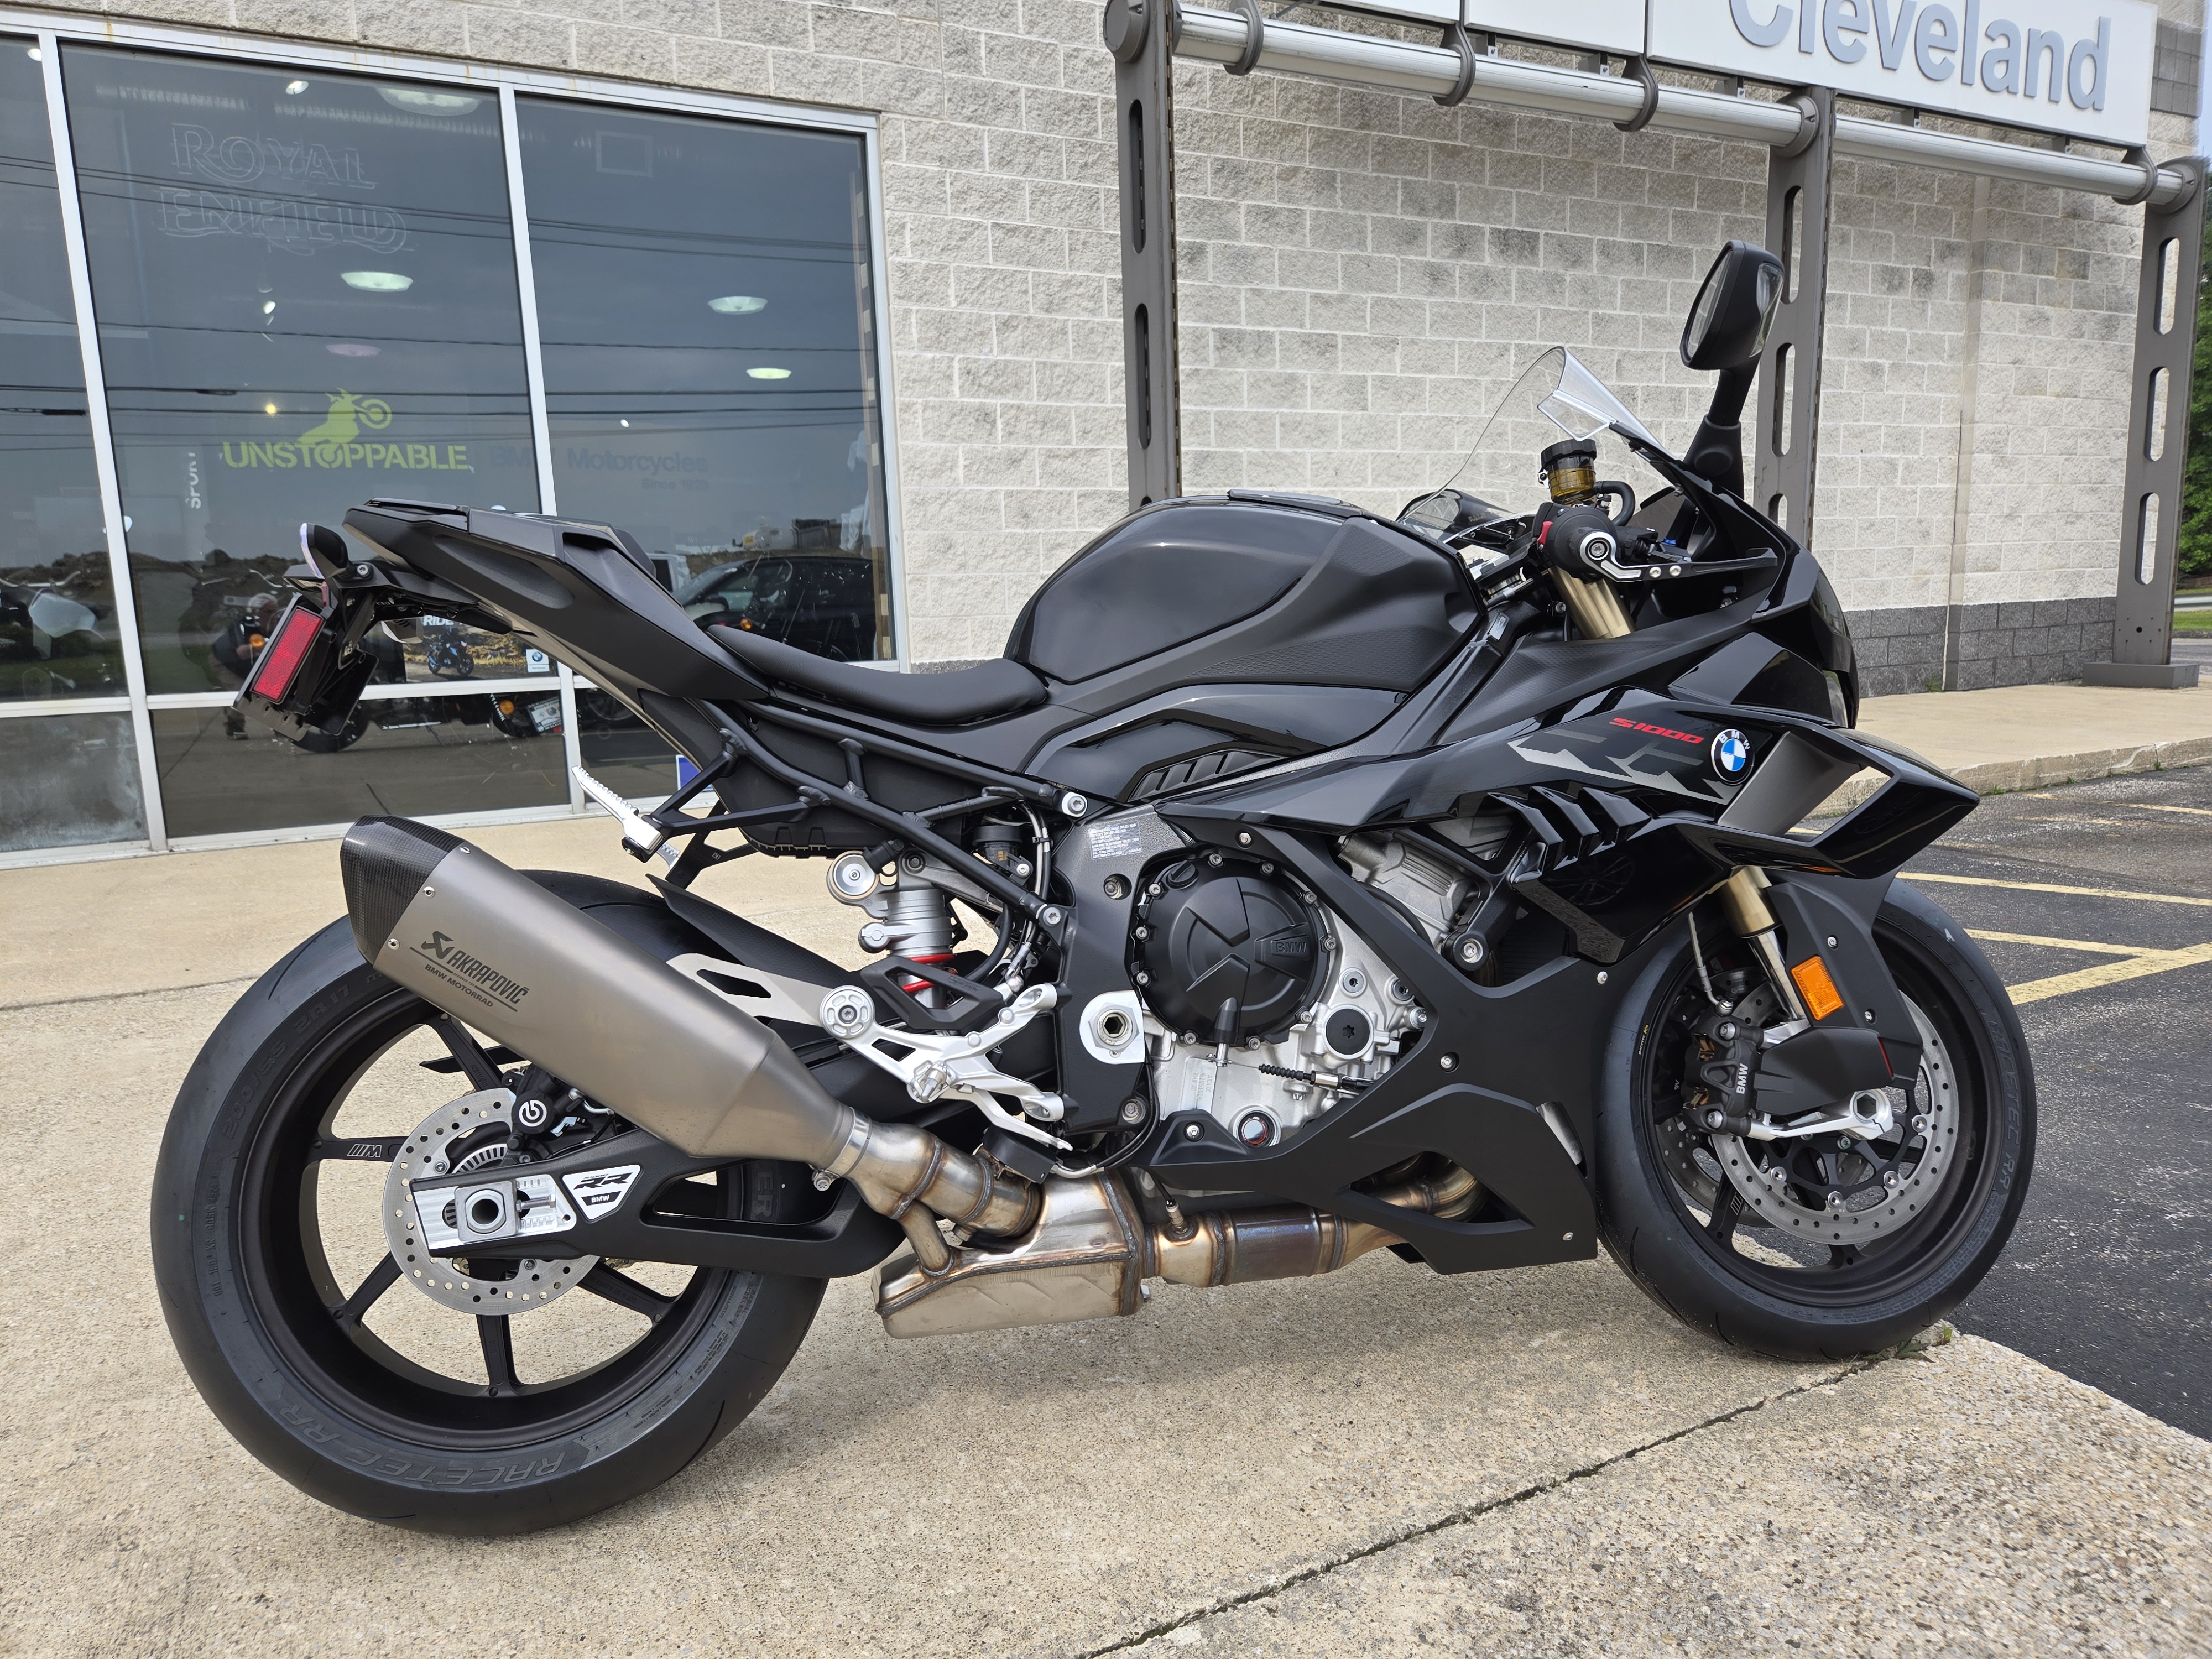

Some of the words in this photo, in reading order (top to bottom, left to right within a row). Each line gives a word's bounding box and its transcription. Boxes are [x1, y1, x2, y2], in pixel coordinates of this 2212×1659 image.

[170, 122, 377, 189] ROYAL
[159, 186, 407, 254] ENFIELD
[223, 442, 469, 470] UNSTOPPABLE
[567, 447, 709, 475] Motorcycles
[1609, 717, 1705, 744] S1000
[1719, 730, 1751, 750] BMW
[1276, 942, 1307, 952] BMW
[425, 964, 448, 980] BMW
[447, 977, 494, 1008] MOTORRAD
[1736, 1063, 1749, 1094] BMW
[591, 1194, 609, 1203] BMW
[343, 1445, 567, 1486] RACETEC
